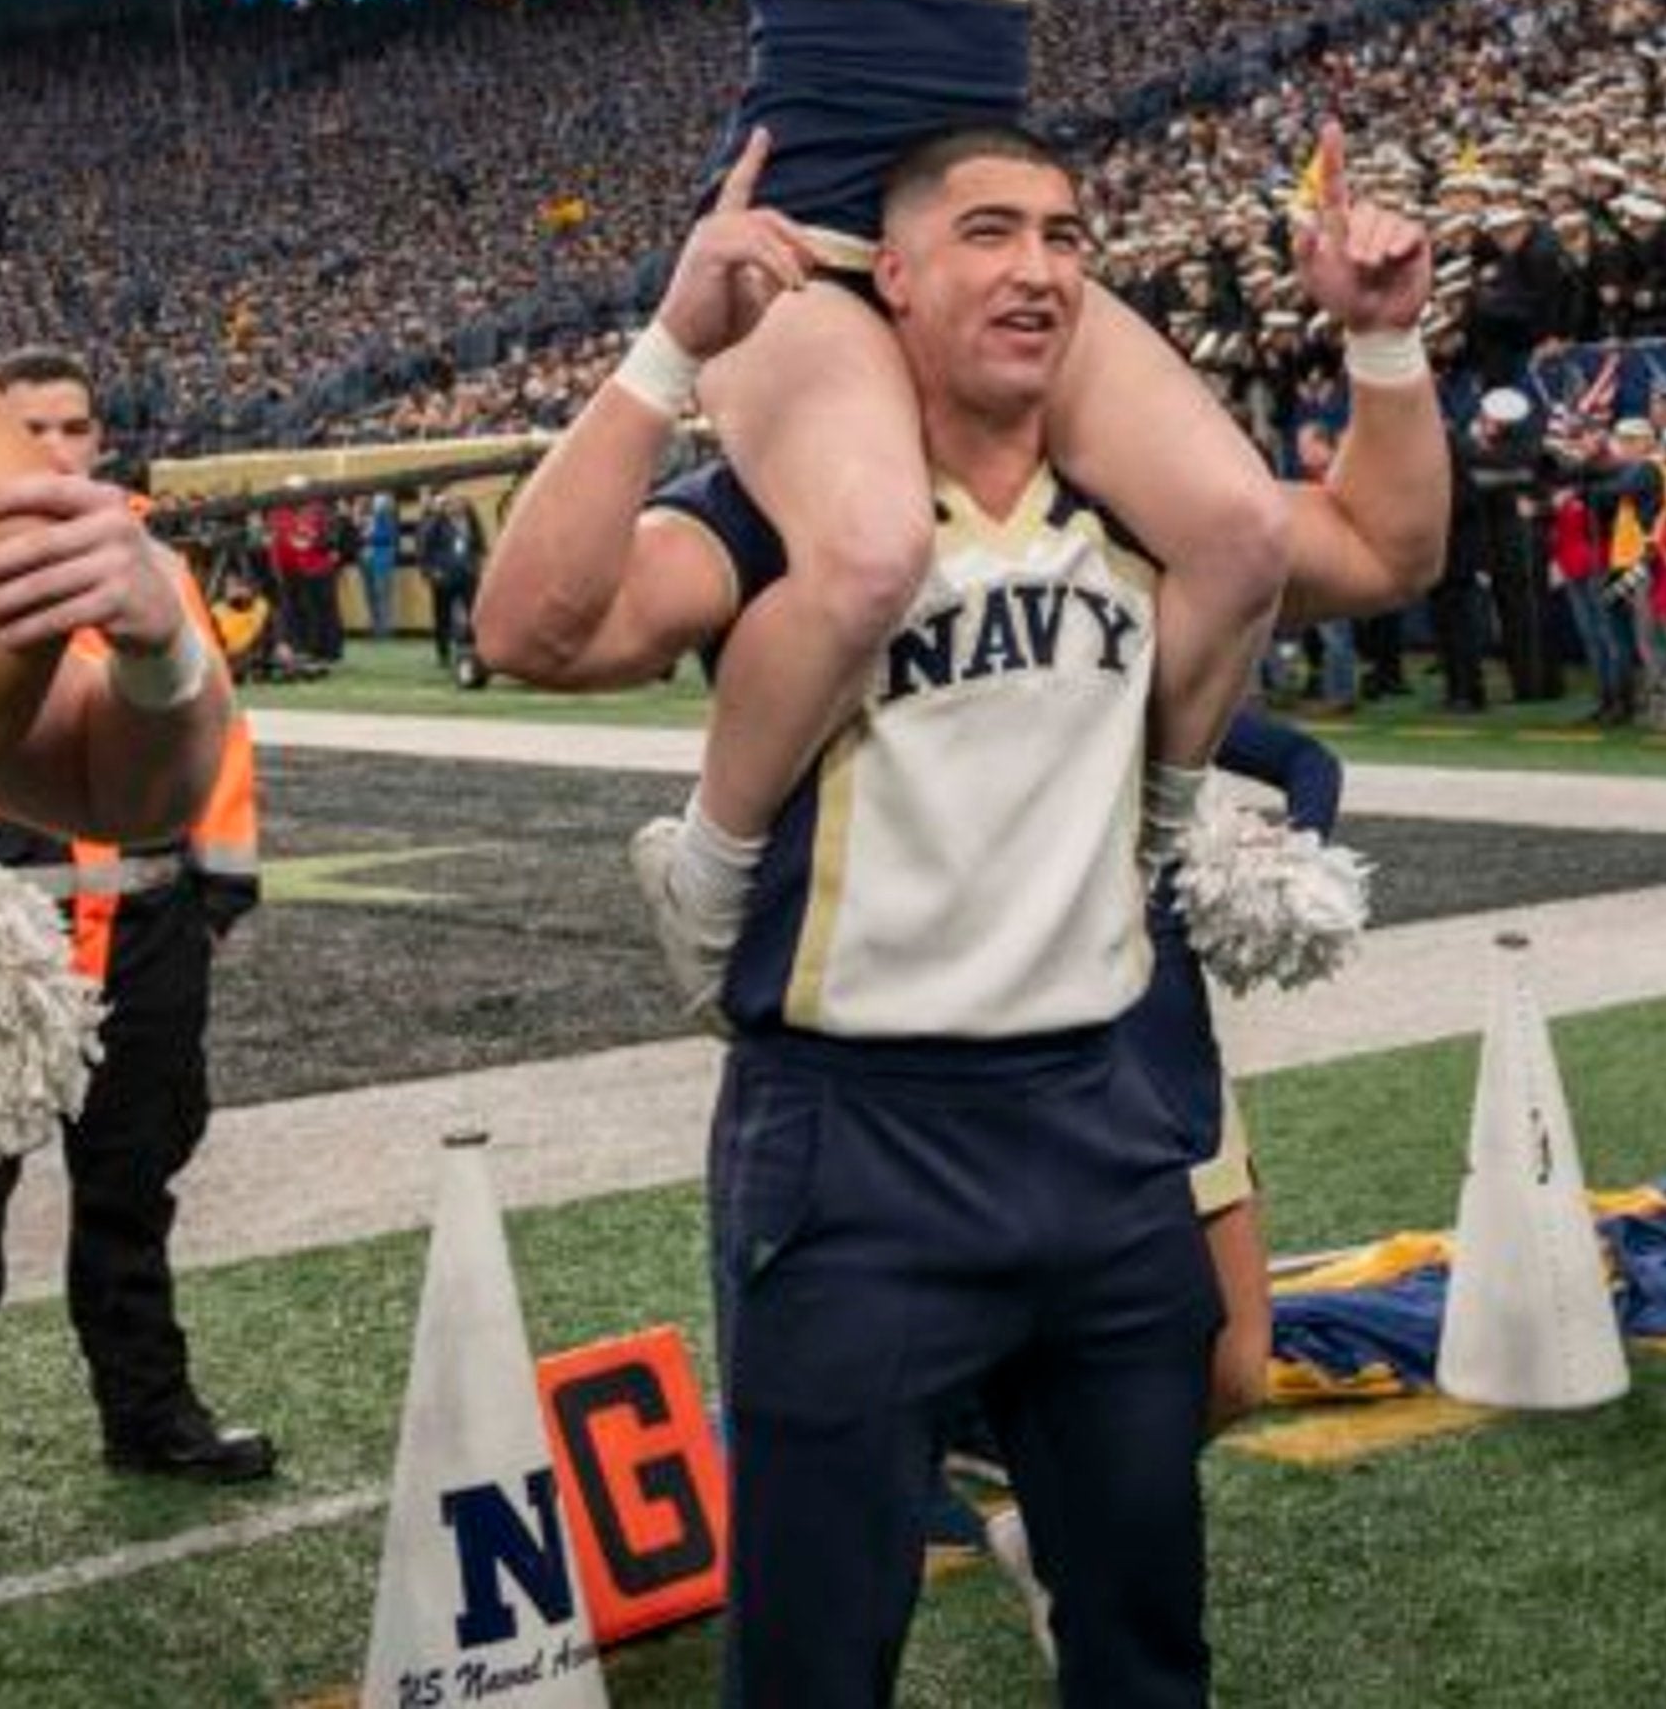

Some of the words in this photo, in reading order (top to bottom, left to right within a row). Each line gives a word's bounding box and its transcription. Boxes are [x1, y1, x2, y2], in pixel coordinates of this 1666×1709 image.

[879, 584, 1136, 704] NAVY
[440, 1468, 575, 1649] N
[554, 1360, 716, 1598] G
